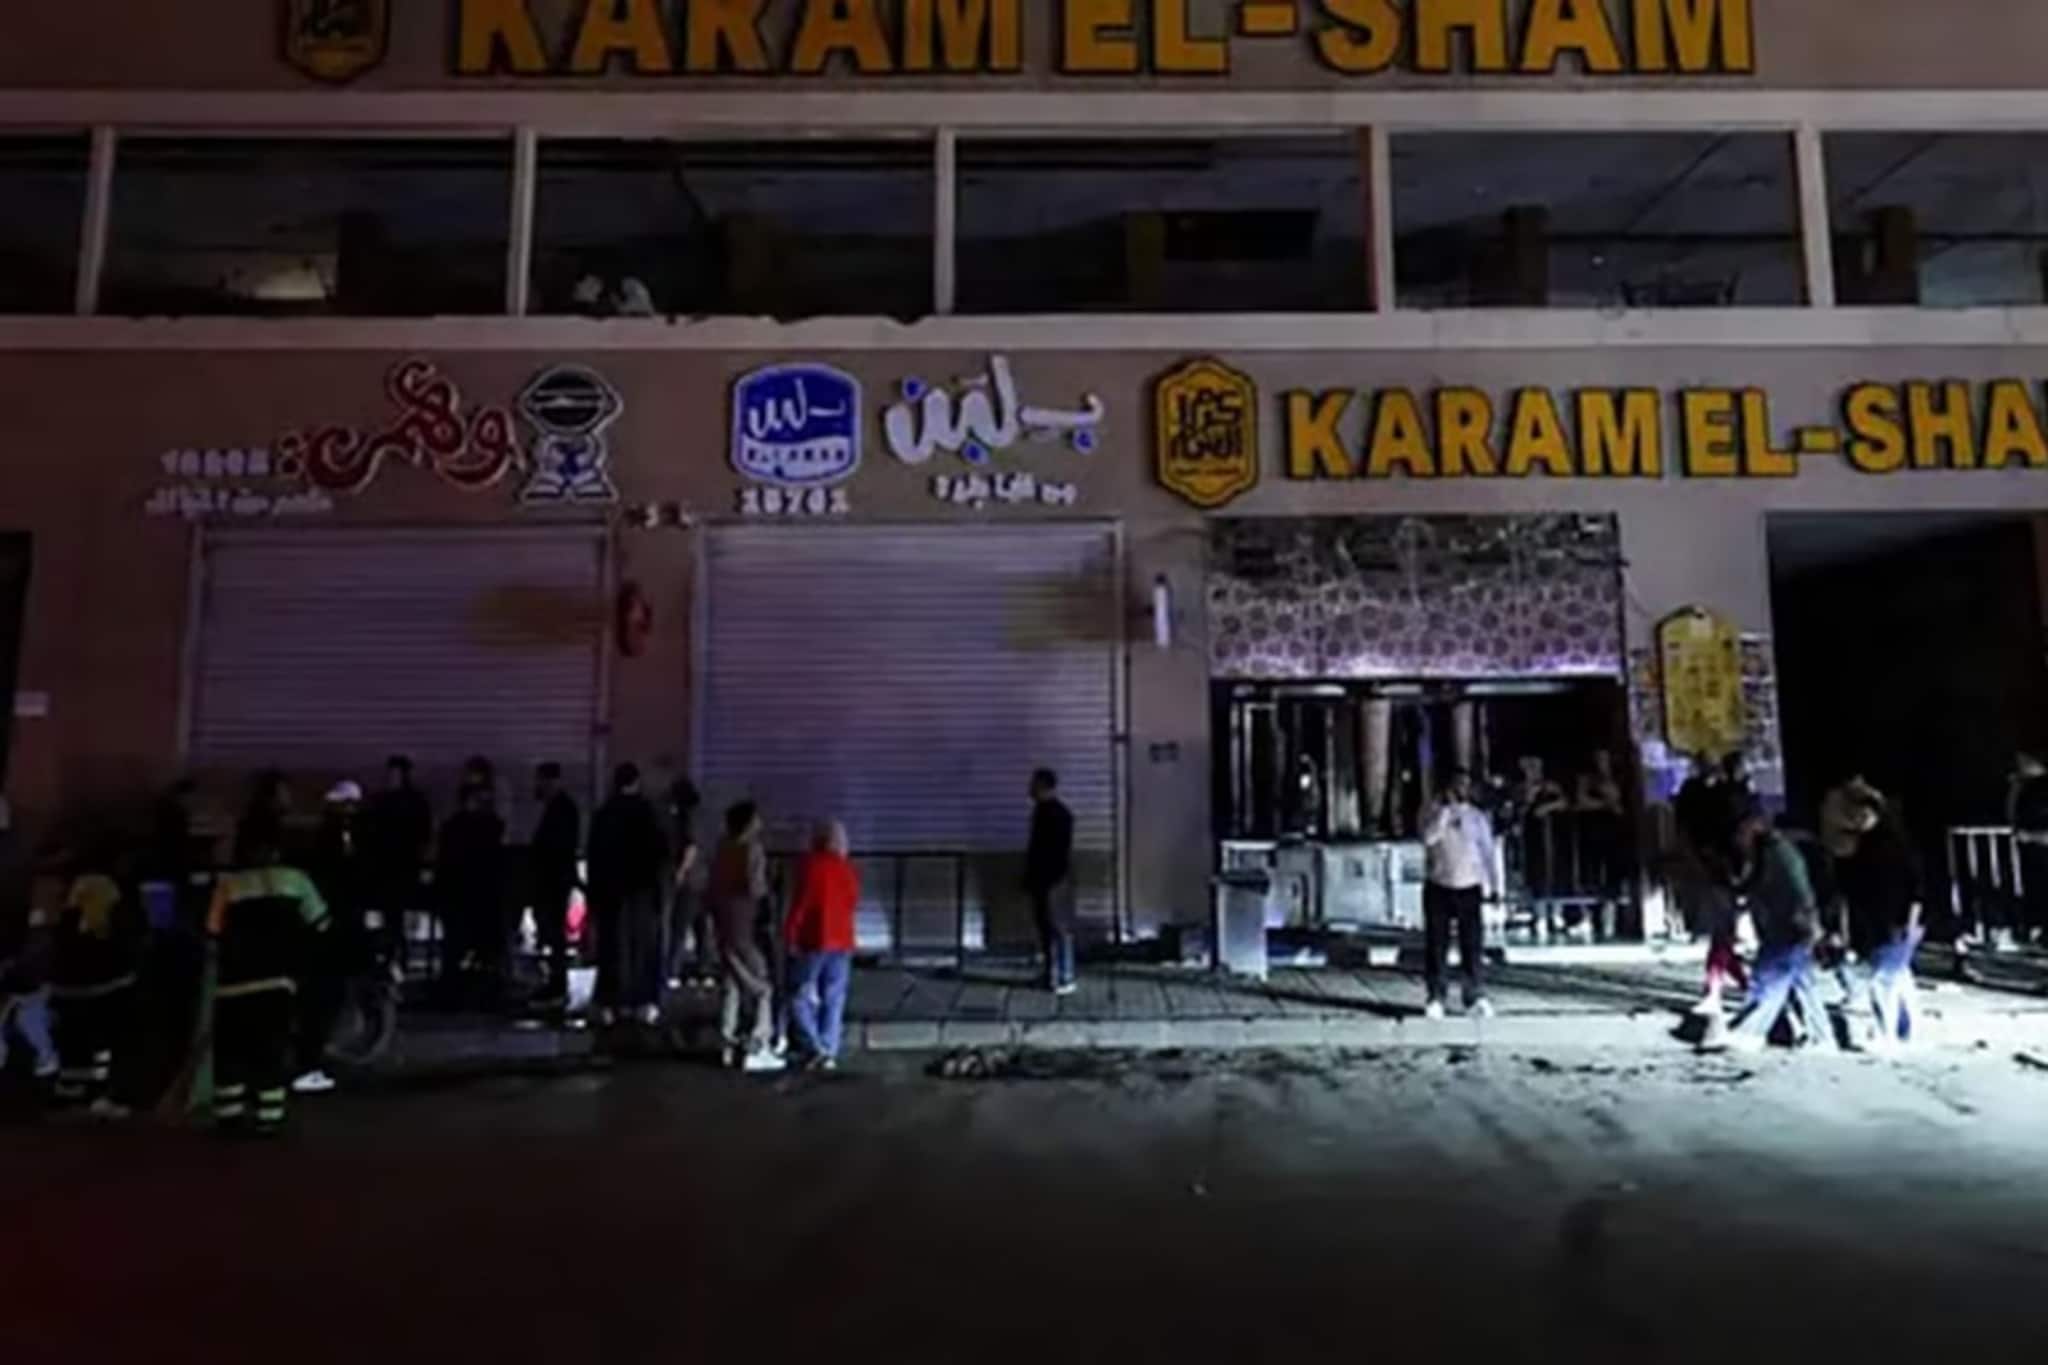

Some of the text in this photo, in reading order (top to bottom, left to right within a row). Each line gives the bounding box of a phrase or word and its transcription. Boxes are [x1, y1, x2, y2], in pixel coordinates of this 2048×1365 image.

[455, 0, 1022, 75] KARAM
[1283, 379, 2048, 478] KARAM EL-SHA
